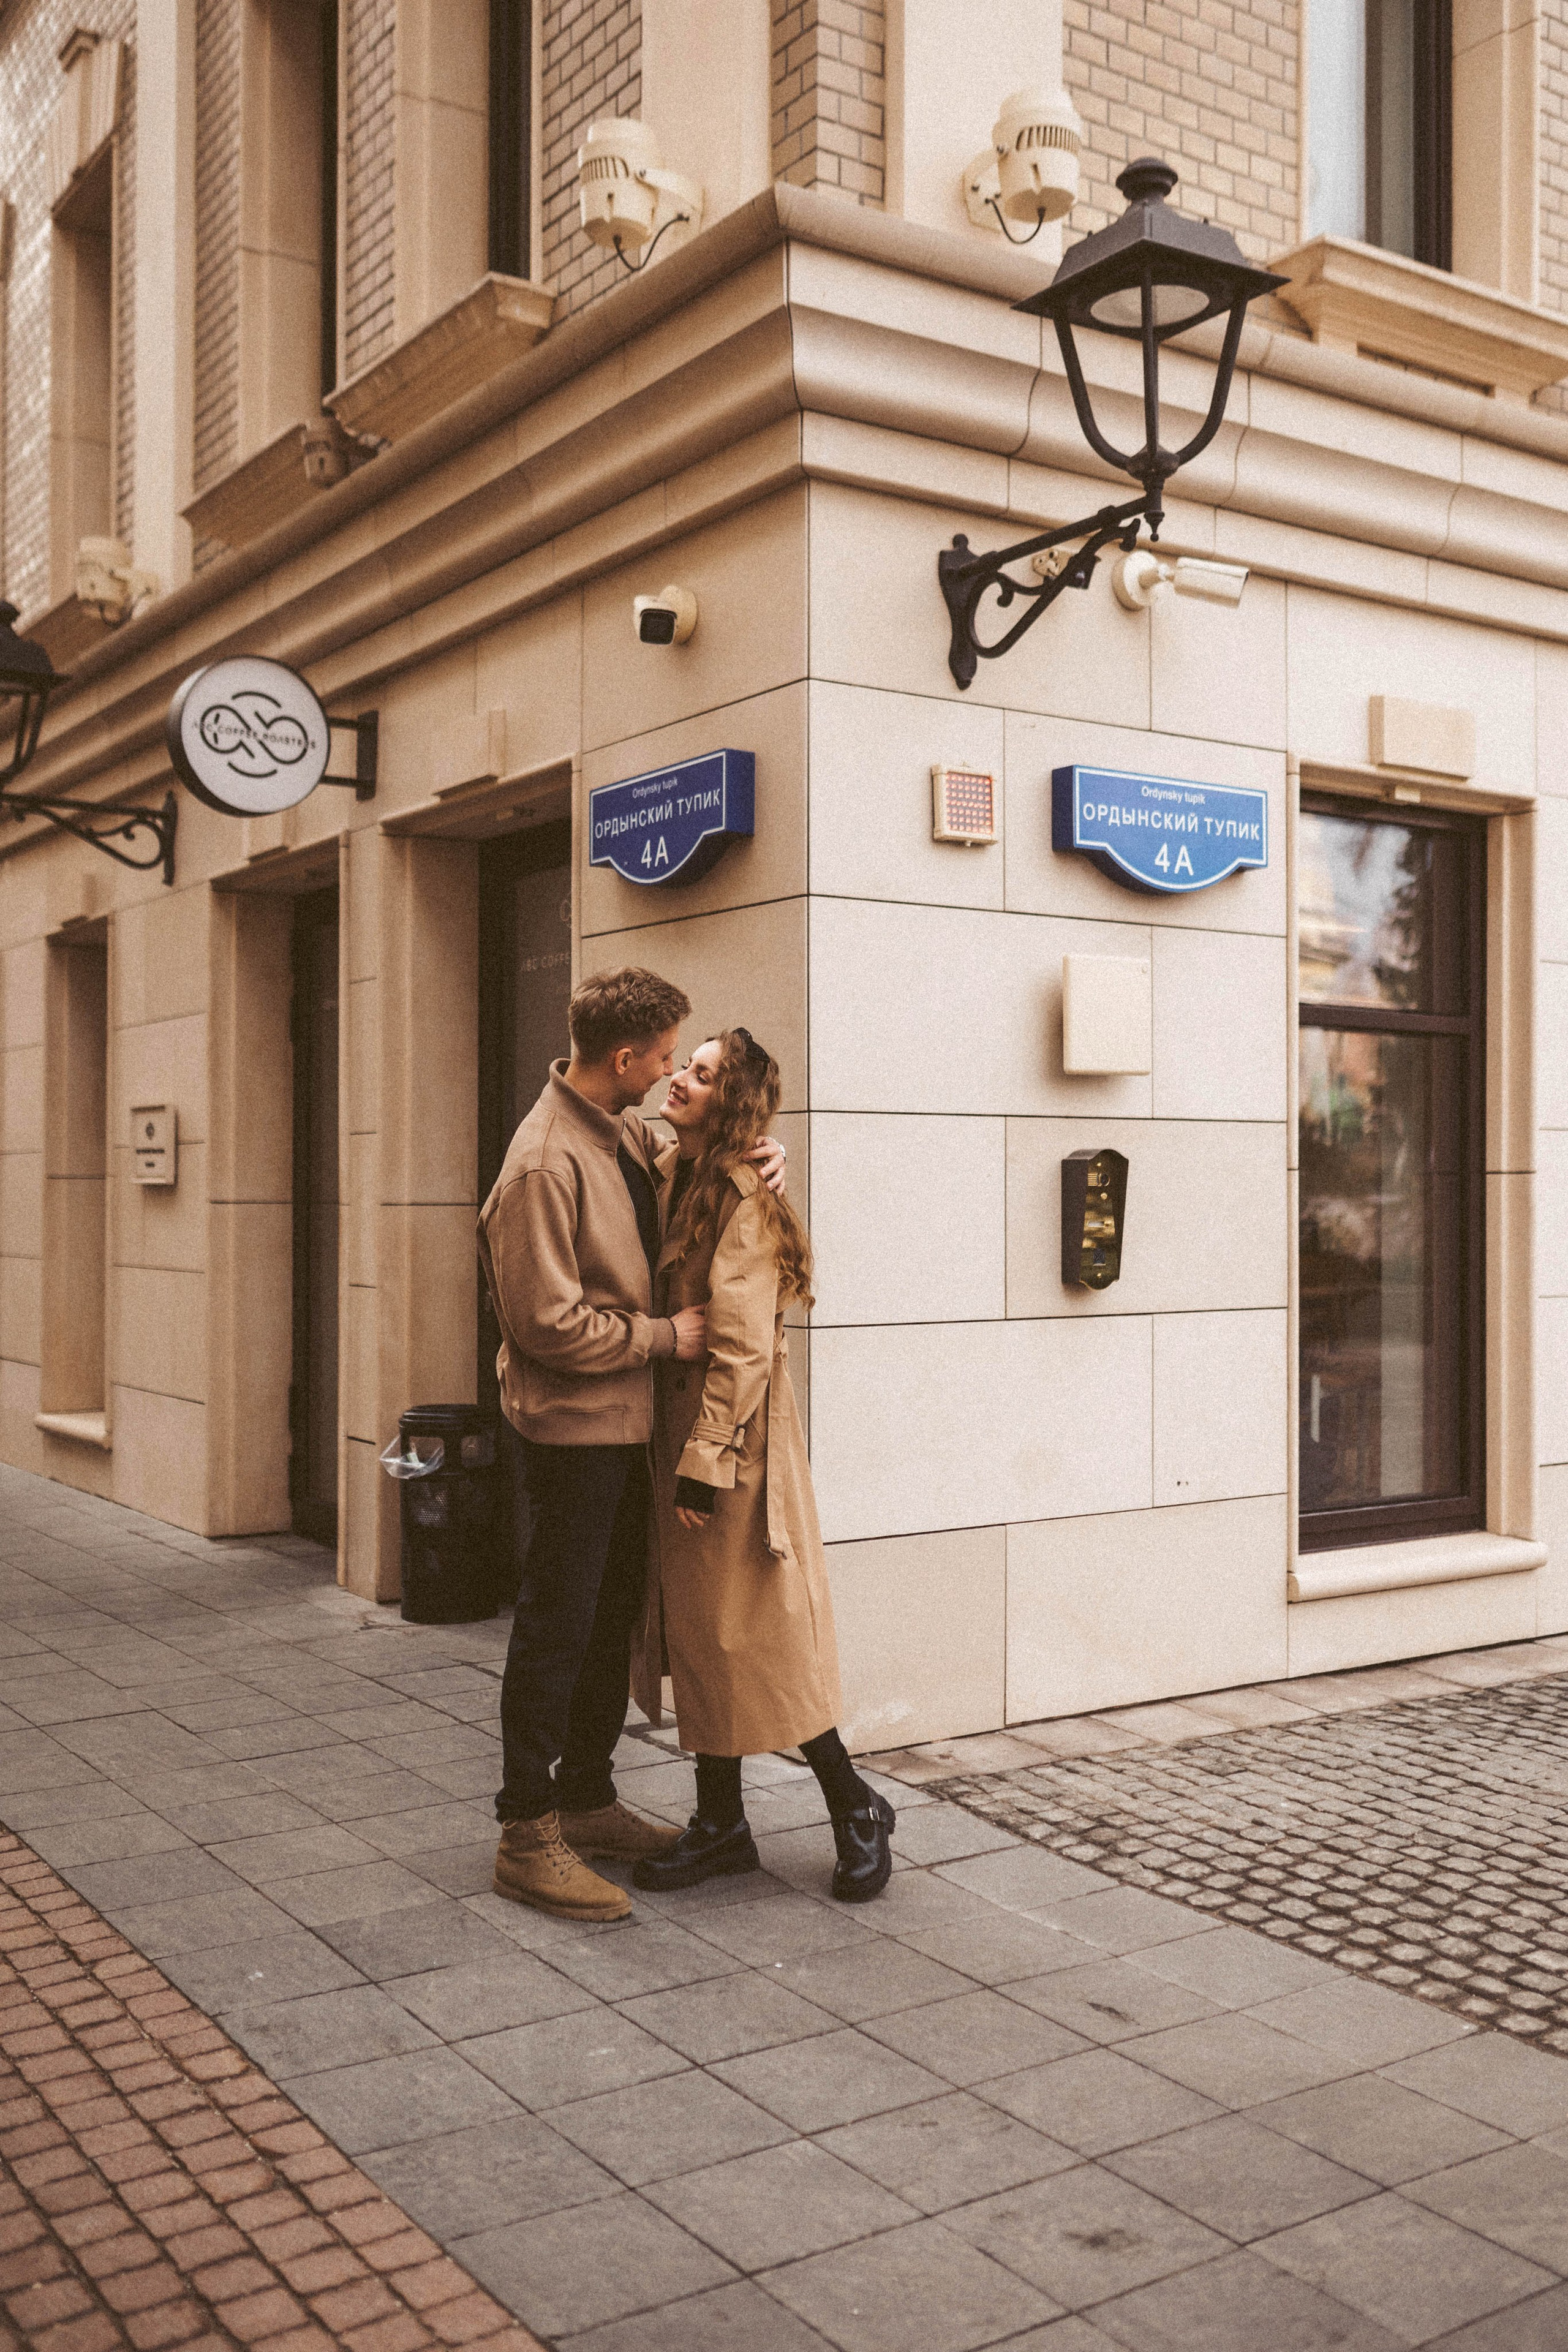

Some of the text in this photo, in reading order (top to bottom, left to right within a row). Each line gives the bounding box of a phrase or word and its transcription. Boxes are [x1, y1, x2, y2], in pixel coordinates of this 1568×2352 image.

[193, 721, 213, 733] AC
[632, 775, 678, 799] Ordynsky tupik
[1141, 785, 1206, 805] Ordynsky tupik
[595, 788, 720, 839] ОРДЫНСКИЙ ТУПИК
[1082, 803, 1260, 841] ОРДЫНСКИЙ ТУПИК
[641, 835, 669, 869] 4А
[1154, 842, 1194, 876] 4А
